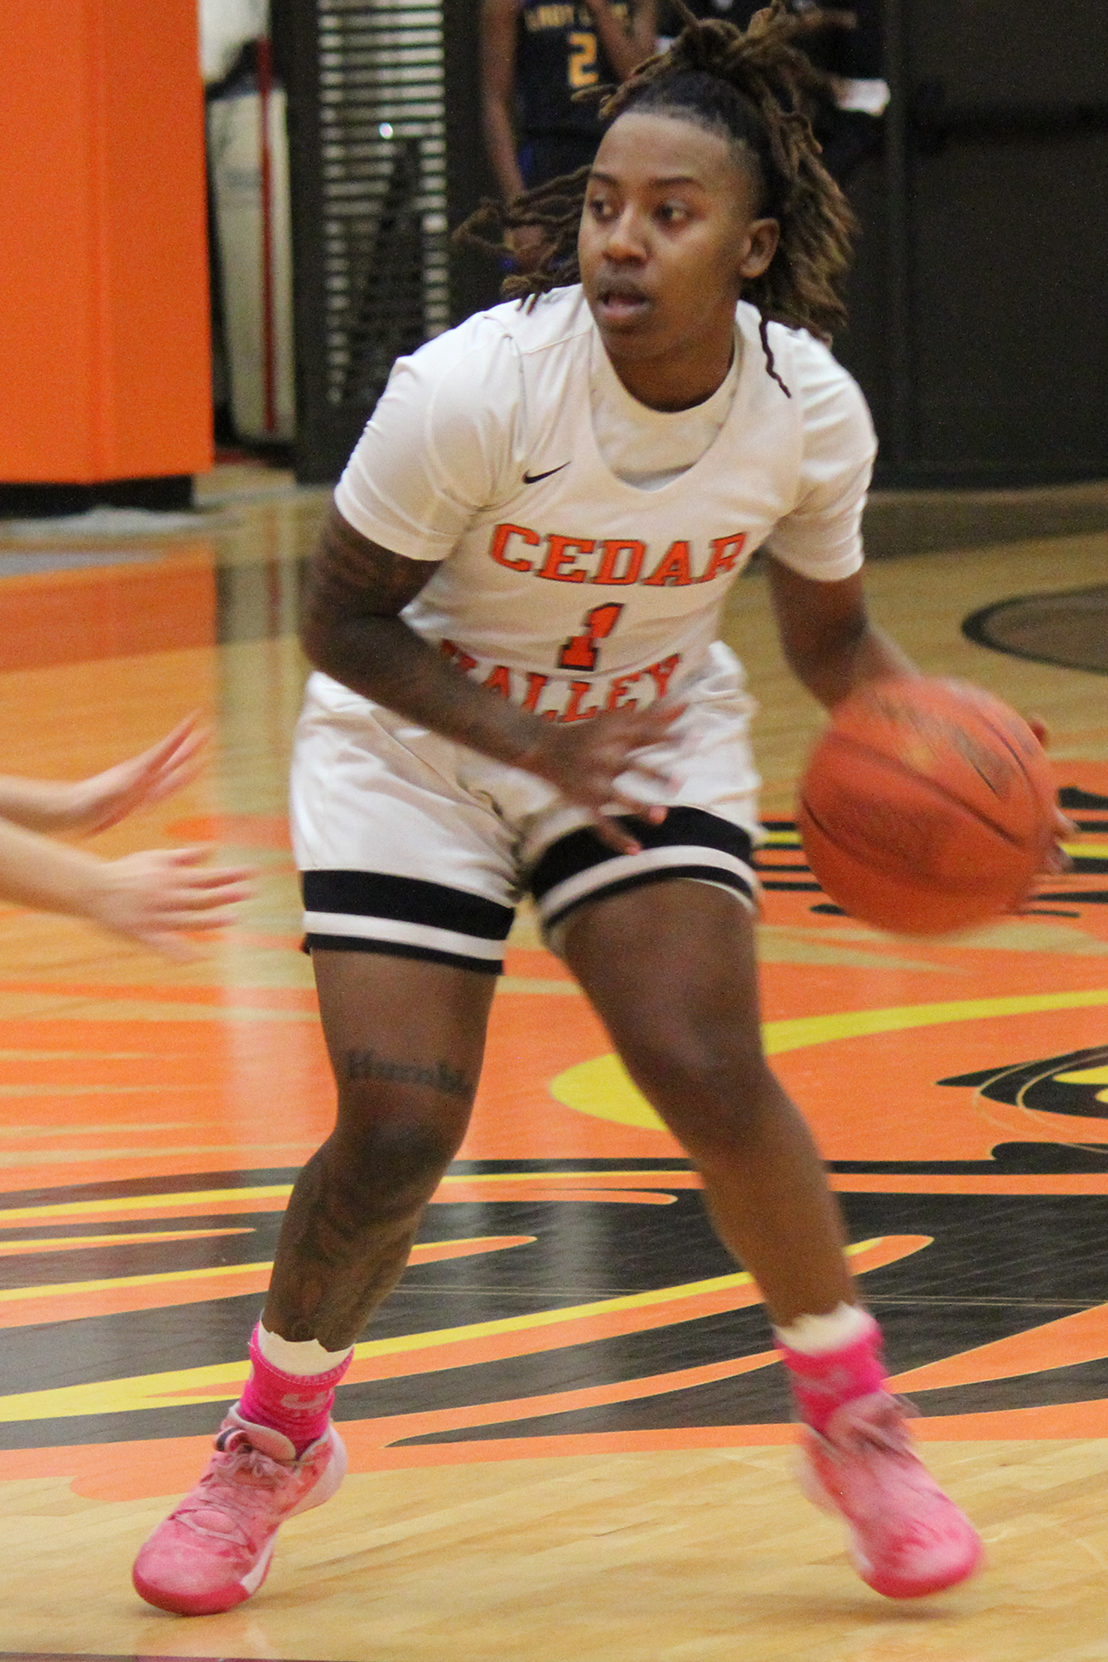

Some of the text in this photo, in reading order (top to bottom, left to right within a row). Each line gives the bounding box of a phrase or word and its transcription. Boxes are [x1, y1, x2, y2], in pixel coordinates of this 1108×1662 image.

[568, 31, 599, 88] 2
[489, 523, 748, 586] CEDAR
[556, 602, 626, 671] 1
